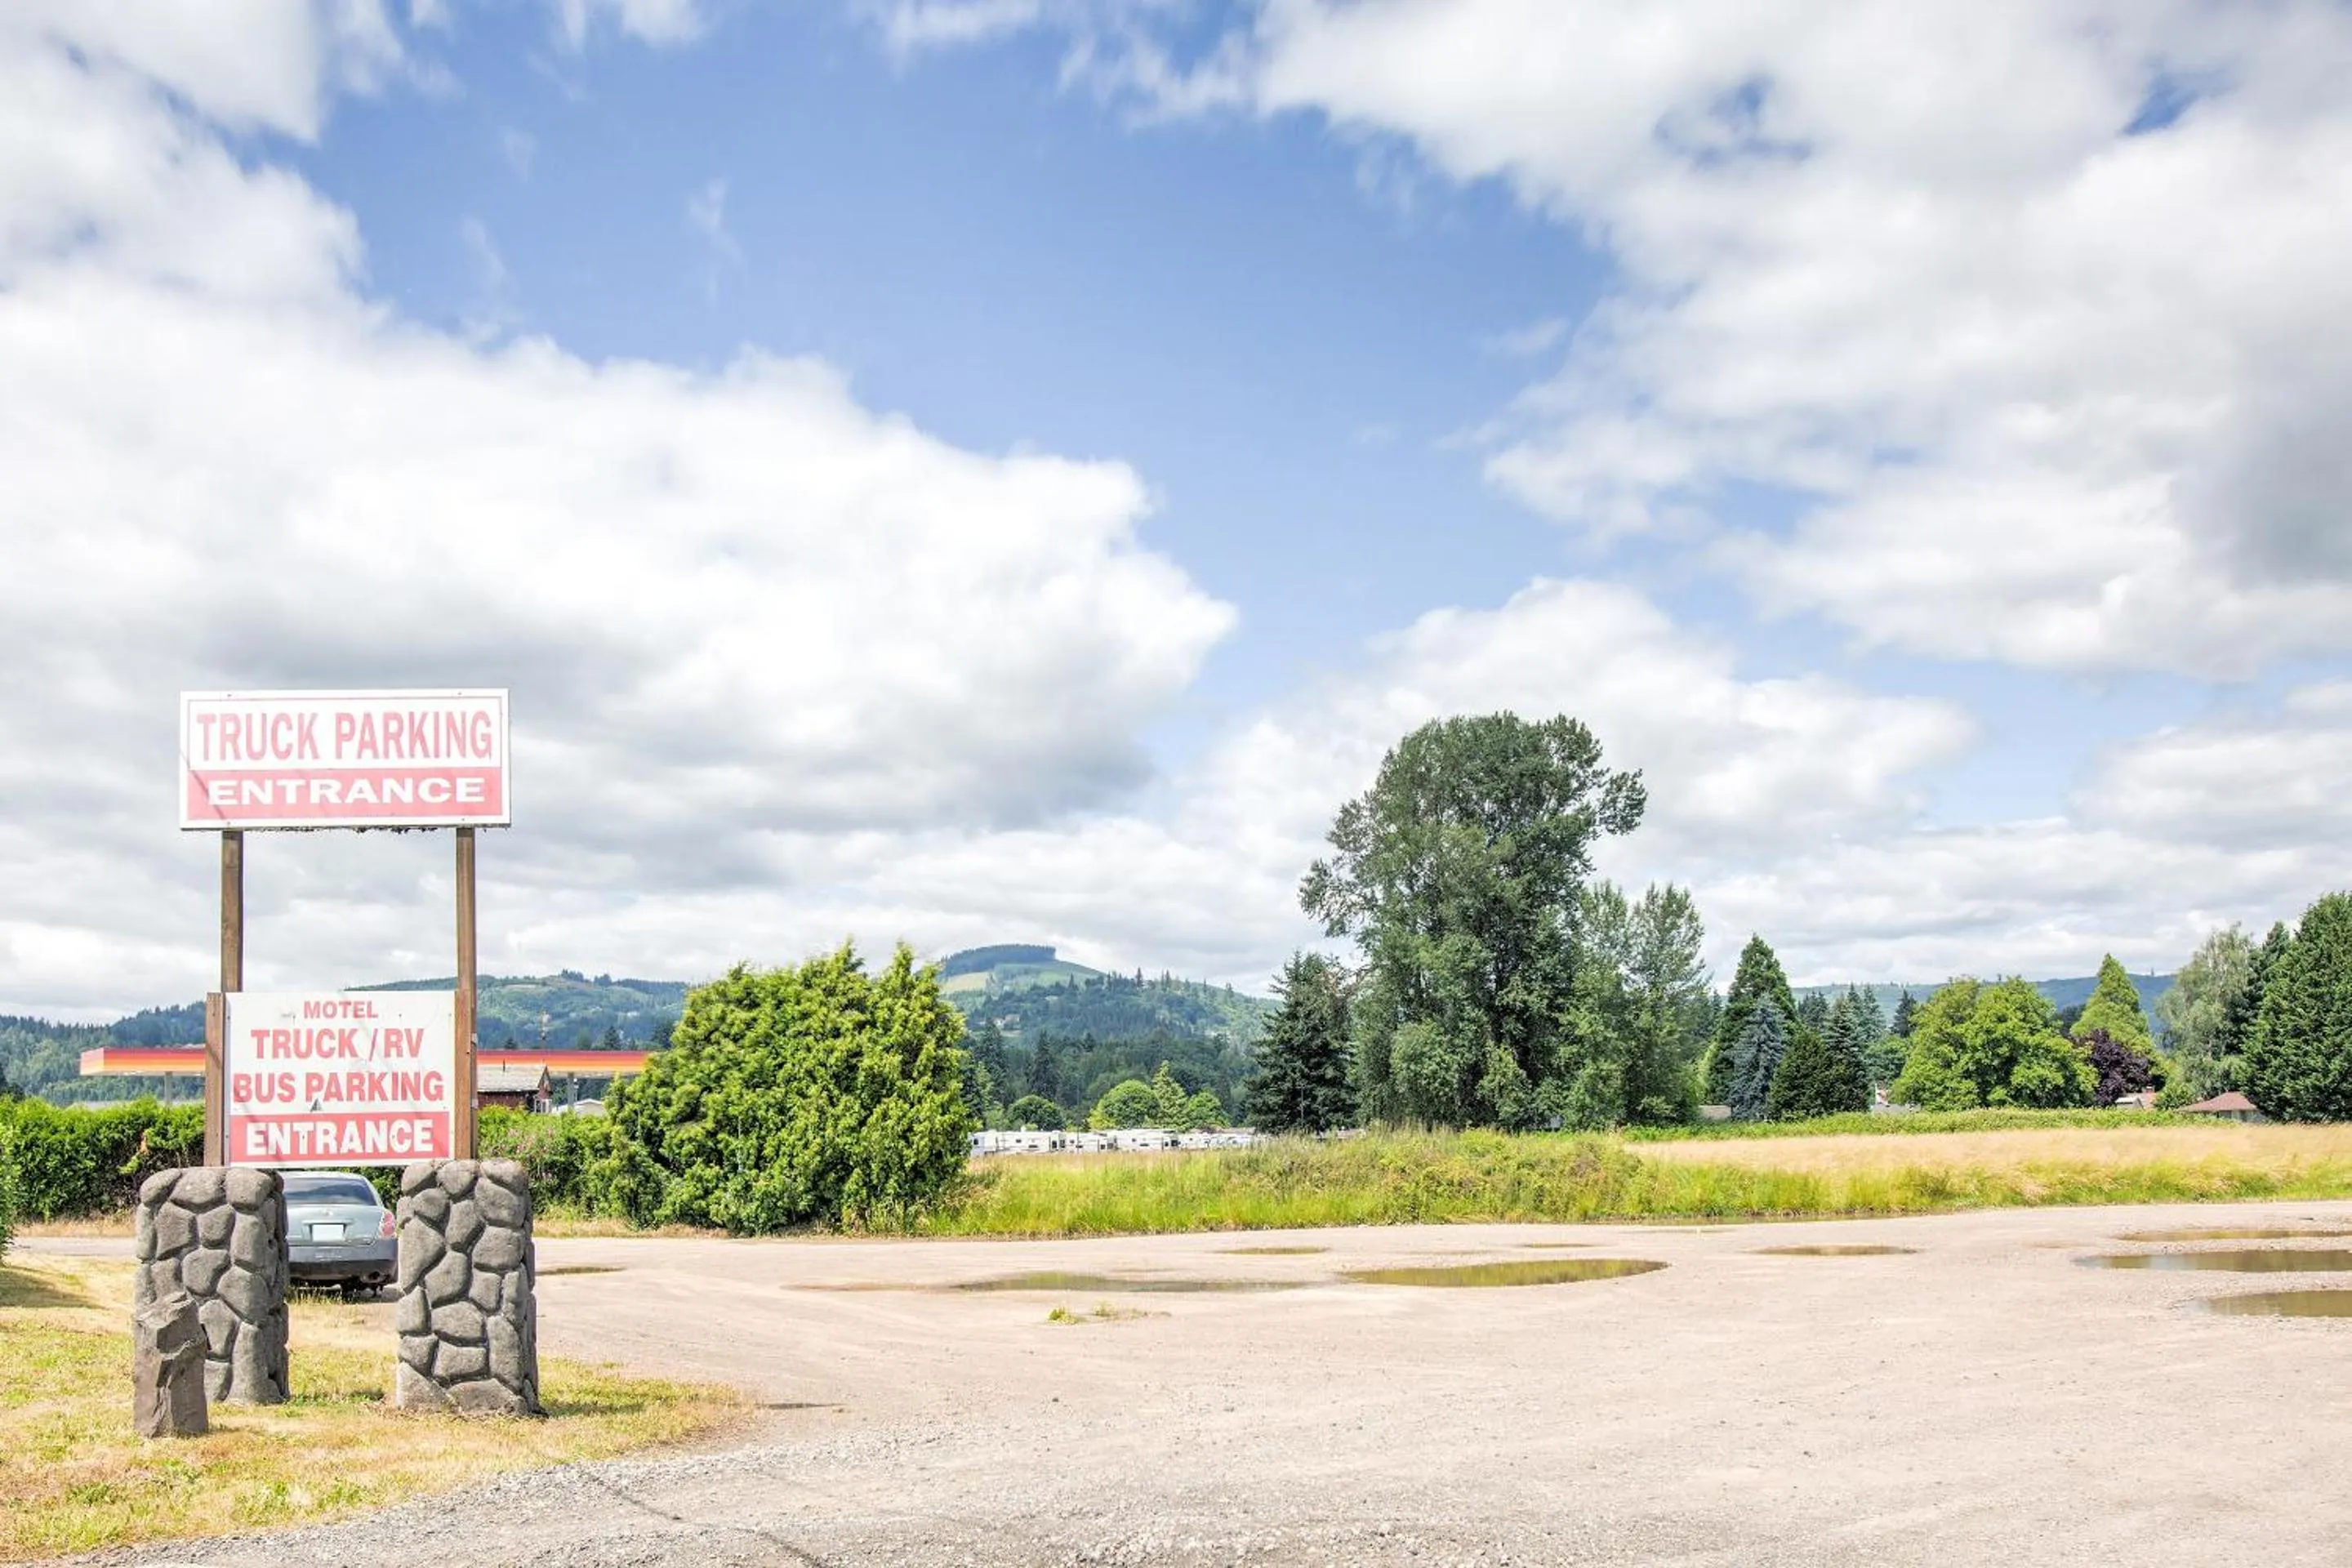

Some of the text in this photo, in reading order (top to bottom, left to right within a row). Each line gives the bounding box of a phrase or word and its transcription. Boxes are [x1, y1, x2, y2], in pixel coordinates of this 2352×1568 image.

[197, 710, 492, 761] TRUCK PARKING
[208, 777, 484, 805] ENTRANCE
[304, 1000, 378, 1018] MOTEL
[251, 1028, 359, 1059] TRUCK
[233, 1071, 444, 1103] BUS PARKING
[246, 1119, 434, 1156] ENTRANCE
